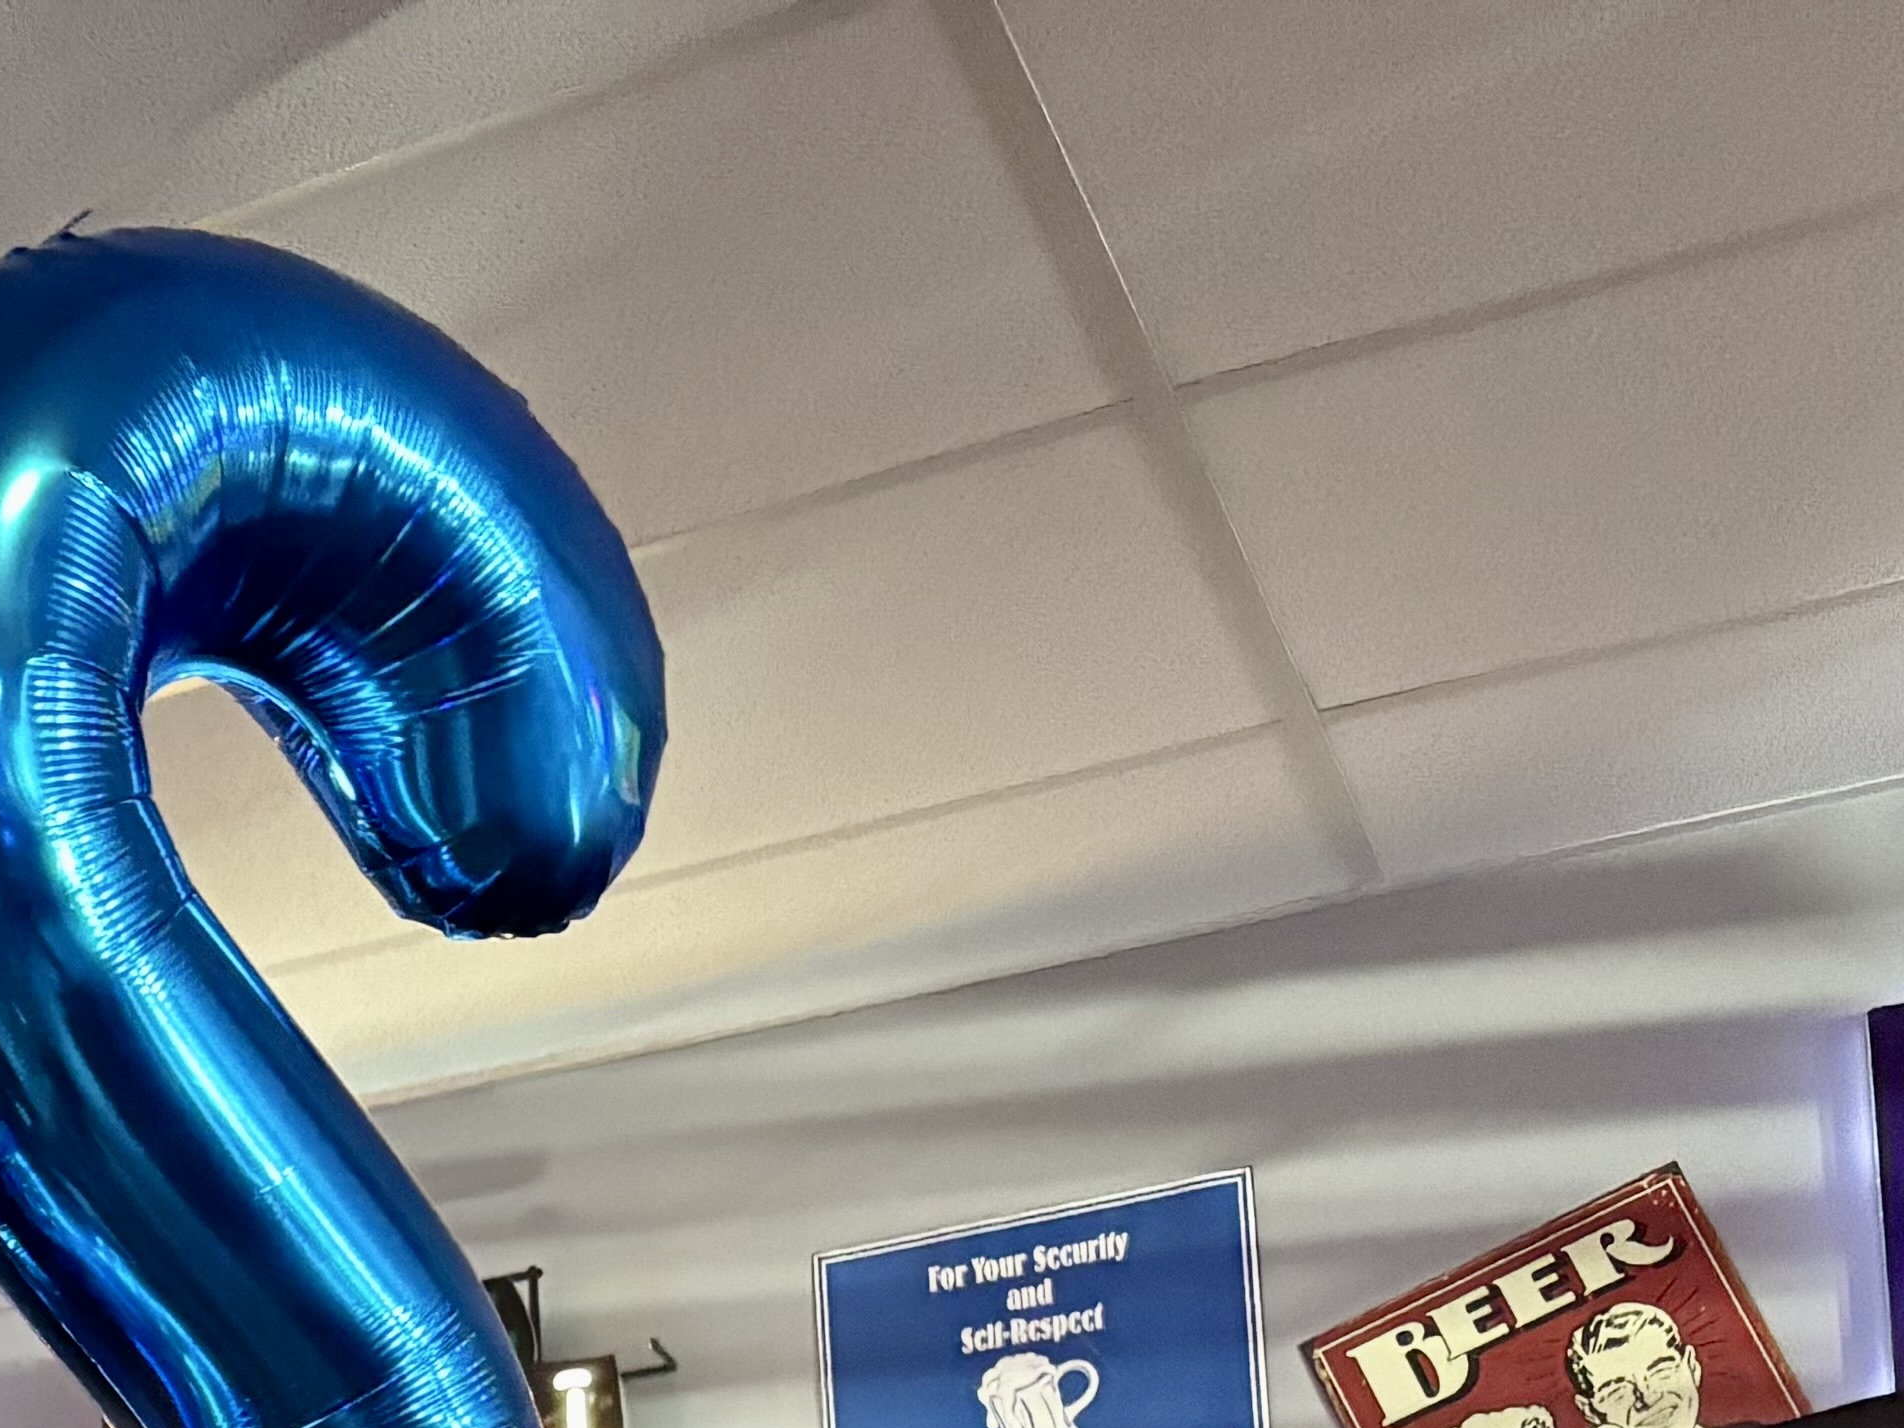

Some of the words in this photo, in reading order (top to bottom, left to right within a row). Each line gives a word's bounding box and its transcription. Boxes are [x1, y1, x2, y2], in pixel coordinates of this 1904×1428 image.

[928, 1263, 968, 1293] For
[971, 1253, 1027, 1284] Your
[1033, 1231, 1130, 1273] Security
[1006, 1278, 1053, 1311] and
[1345, 1218, 1674, 1427] BEER
[961, 1302, 1104, 1354] Self-Respect
